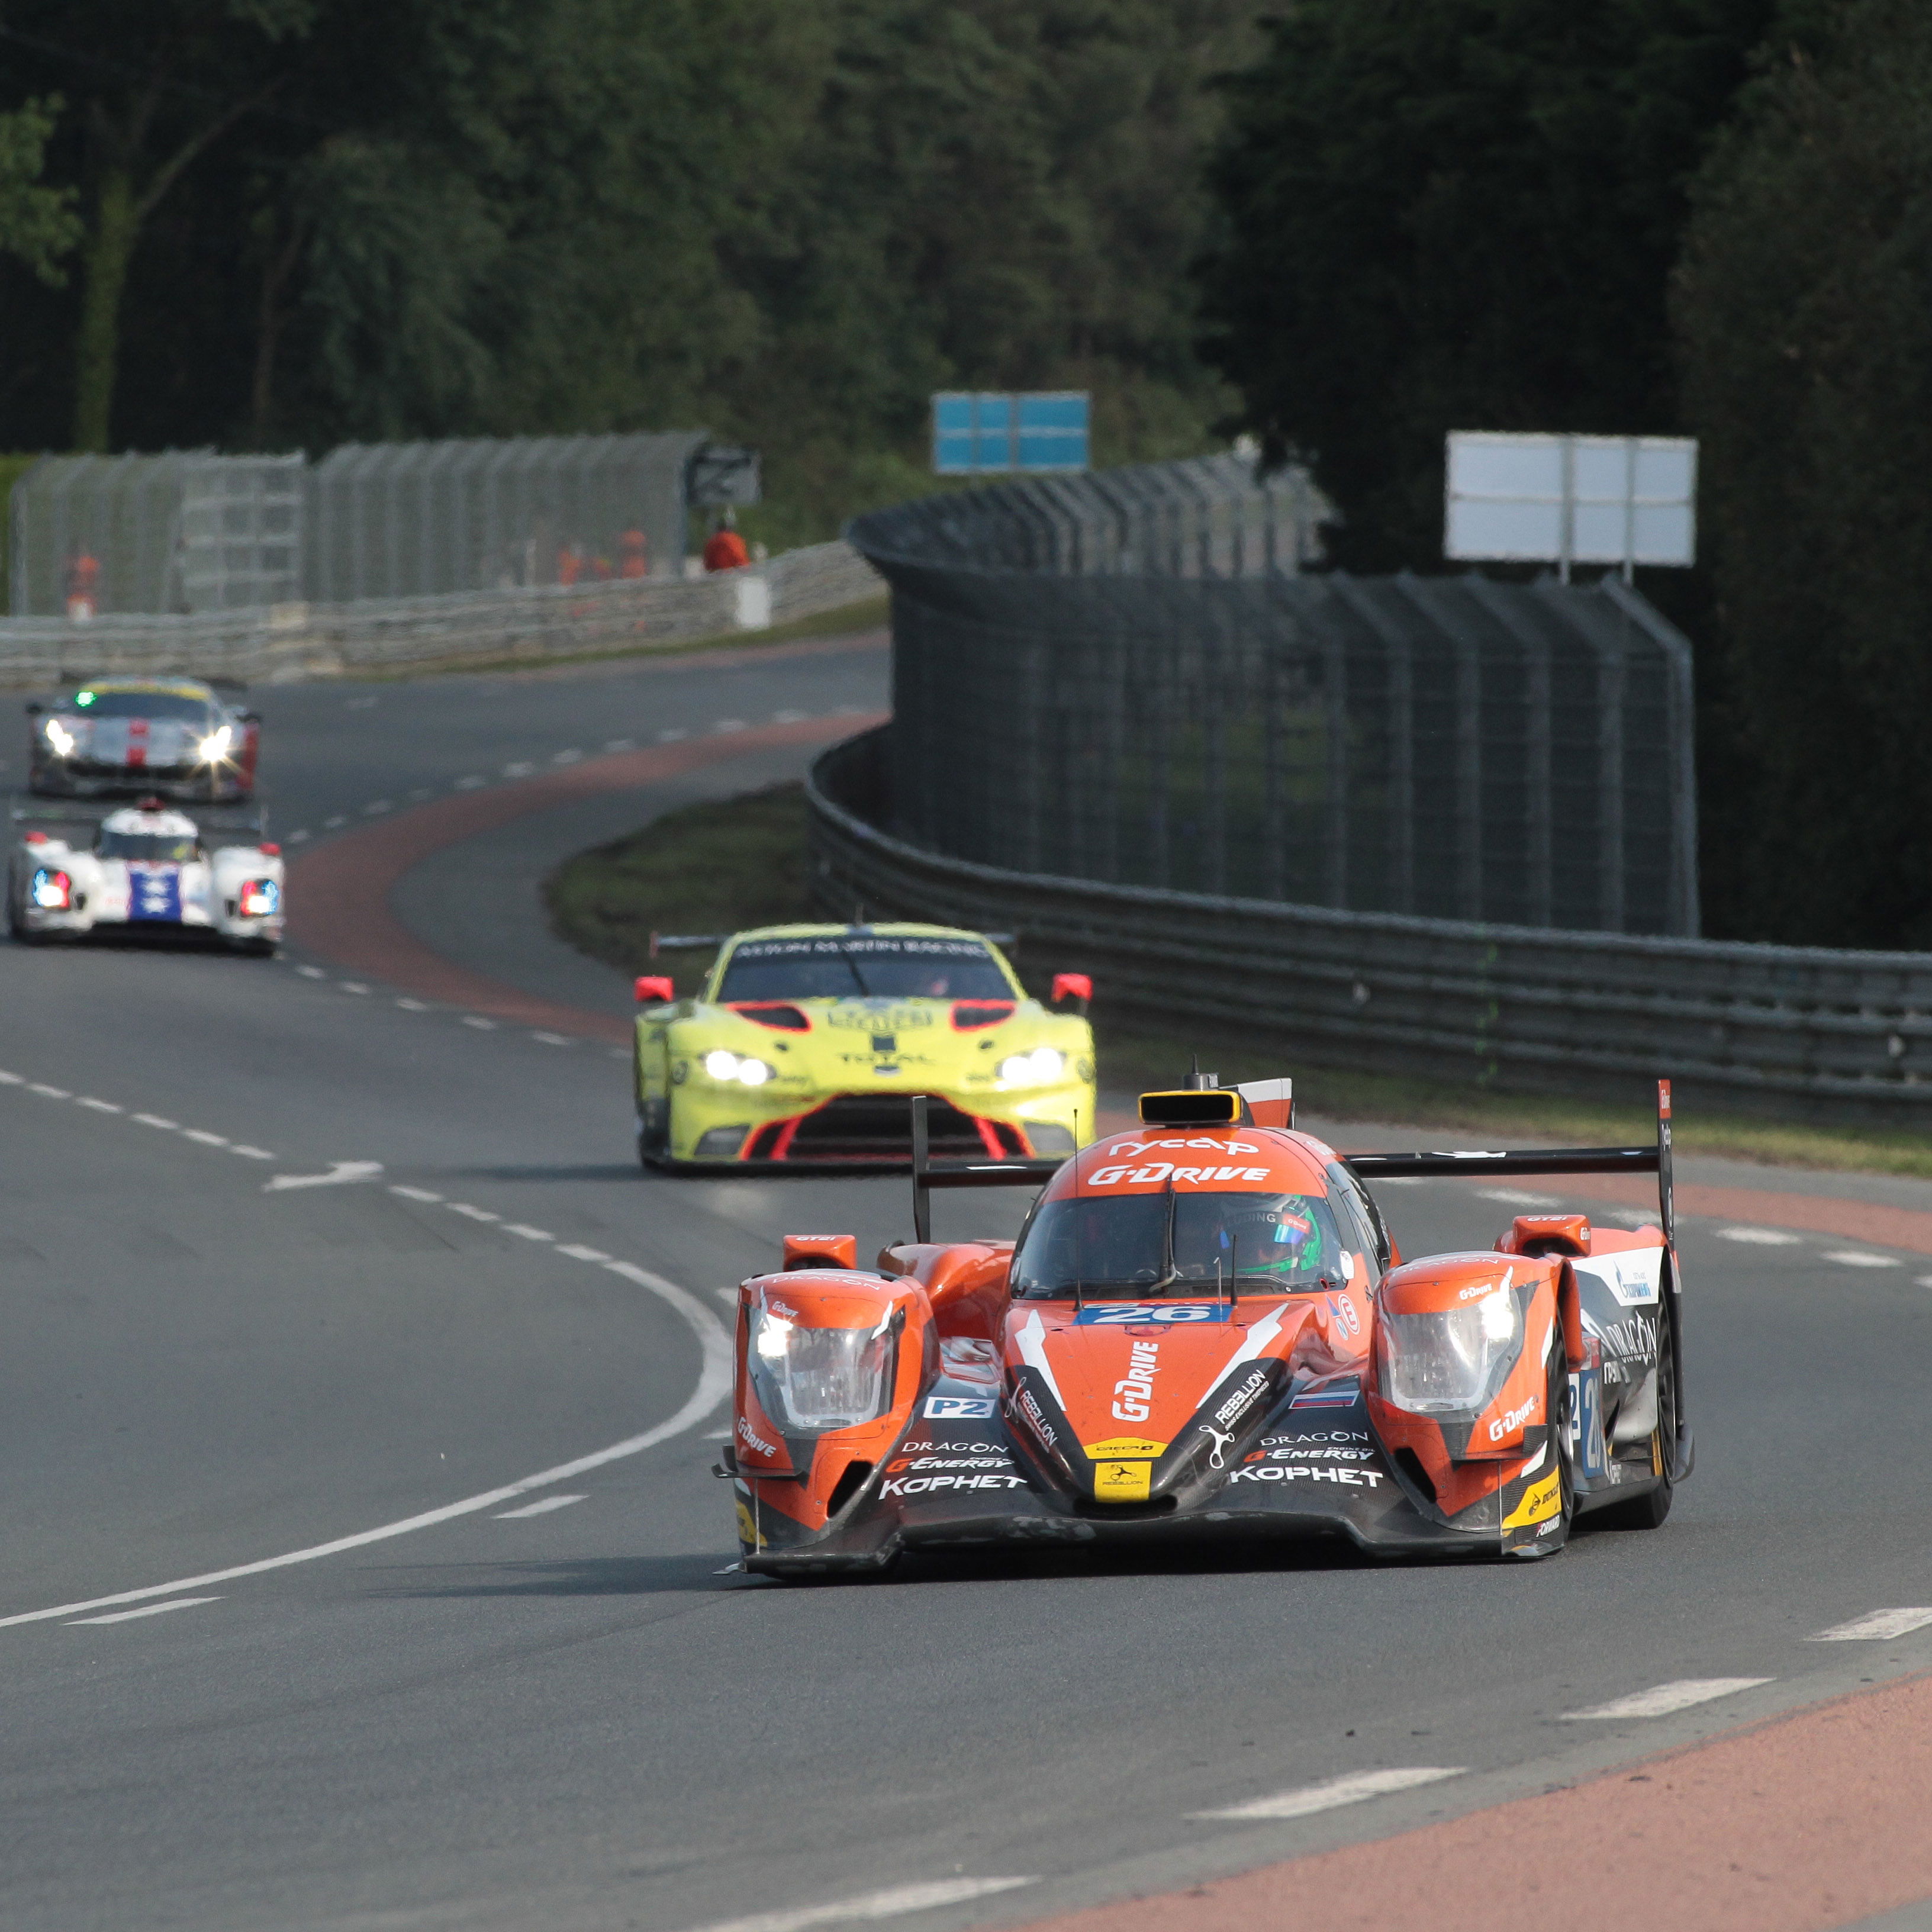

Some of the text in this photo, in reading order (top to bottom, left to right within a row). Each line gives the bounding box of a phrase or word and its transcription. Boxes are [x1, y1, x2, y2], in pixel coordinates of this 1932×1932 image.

[1093, 1306, 1212, 1324] 26
[932, 1399, 990, 1416] P2
[1260, 1431, 1369, 1447] DRAGON
[901, 1442, 1009, 1453] DRAGON
